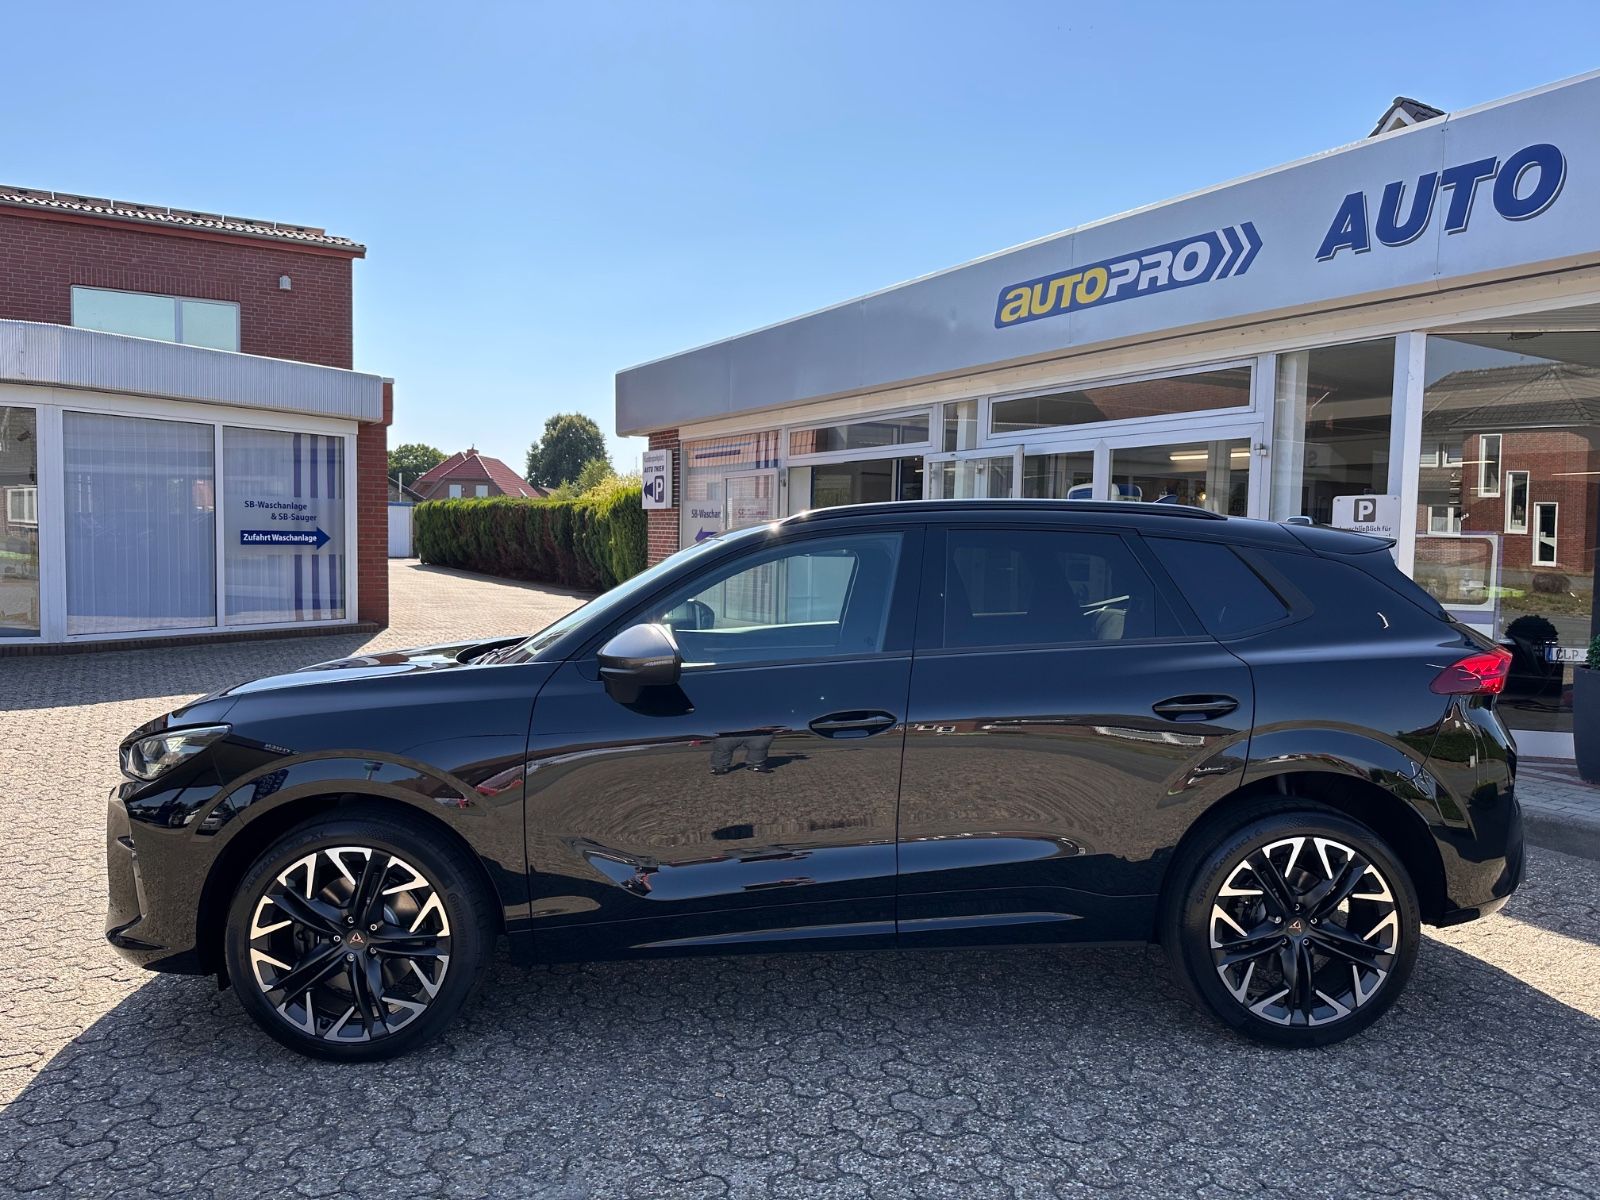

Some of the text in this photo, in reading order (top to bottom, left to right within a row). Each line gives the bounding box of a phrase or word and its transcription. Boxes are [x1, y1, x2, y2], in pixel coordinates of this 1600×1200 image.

[1315, 143, 1567, 262] AUTO
[655, 478, 664, 501] P
[244, 500, 308, 512] SB-Waschanlage
[1358, 500, 1374, 521] P
[270, 513, 317, 523] & SB-Sauger
[243, 533, 317, 543] Zufahrt Waschanlage
[1556, 649, 1579, 660] CLP
